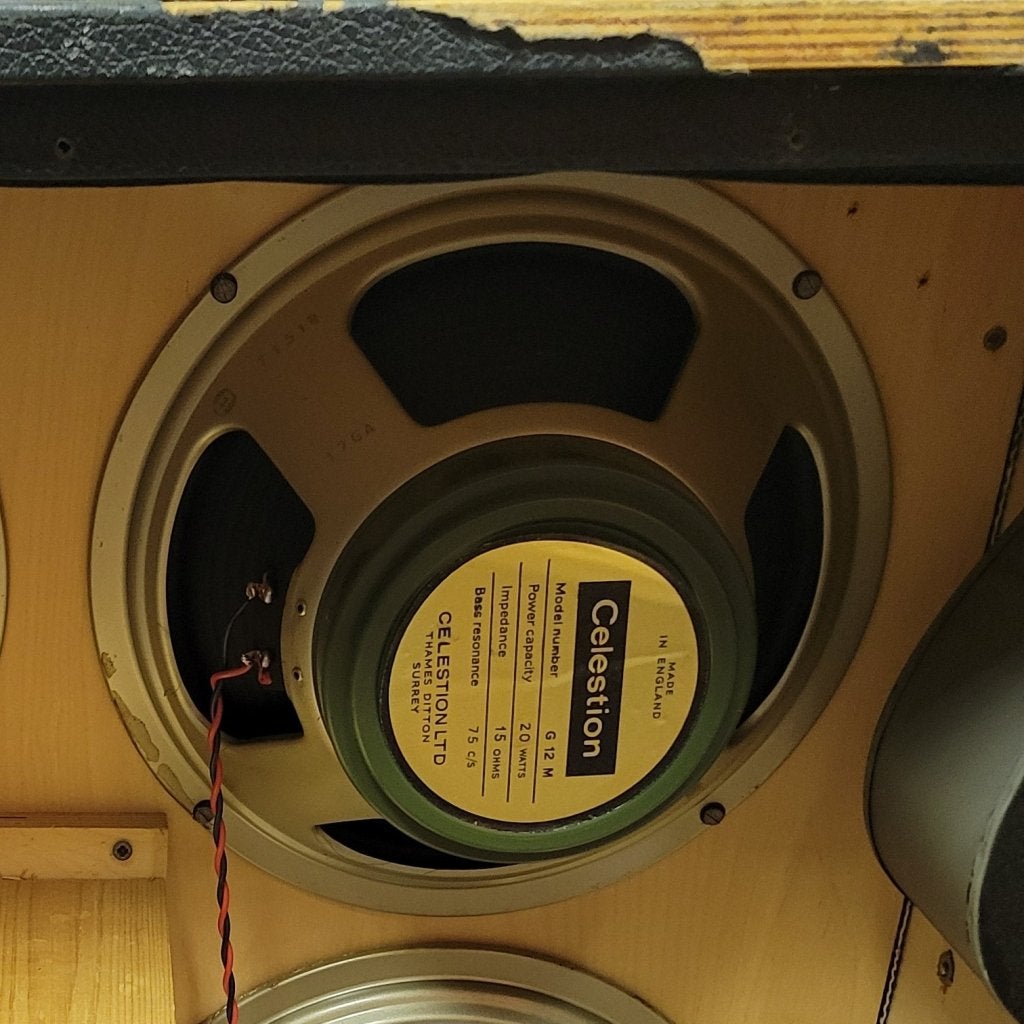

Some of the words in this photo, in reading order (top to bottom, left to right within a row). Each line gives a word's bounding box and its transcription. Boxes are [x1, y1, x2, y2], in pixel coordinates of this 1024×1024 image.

[473, 587, 486, 618] Bass
[526, 584, 540, 626] Power
[553, 582, 566, 625] Model
[498, 585, 513, 657] Impedance
[424, 632, 434, 685] THAMES
[471, 622, 483, 686] resonance
[522, 629, 537, 683] capacity
[549, 629, 563, 678] number
[658, 635, 668, 648] IN
[435, 611, 452, 725] CELESTION
[582, 599, 619, 758] Celestion
[666, 662, 676, 695] MADE
[411, 663, 421, 714] SURREY
[653, 658, 666, 720] ENGLAND
[422, 693, 432, 743] DITTON
[467, 726, 479, 744] 75
[494, 726, 506, 742] 15
[519, 723, 531, 742] 20
[545, 731, 556, 740] G
[434, 730, 447, 766] LTD
[466, 751, 479, 768] c/s
[491, 748, 502, 779] OHMS
[517, 748, 528, 778] WATTS
[544, 748, 555, 760] 12
[542, 768, 554, 778] M
